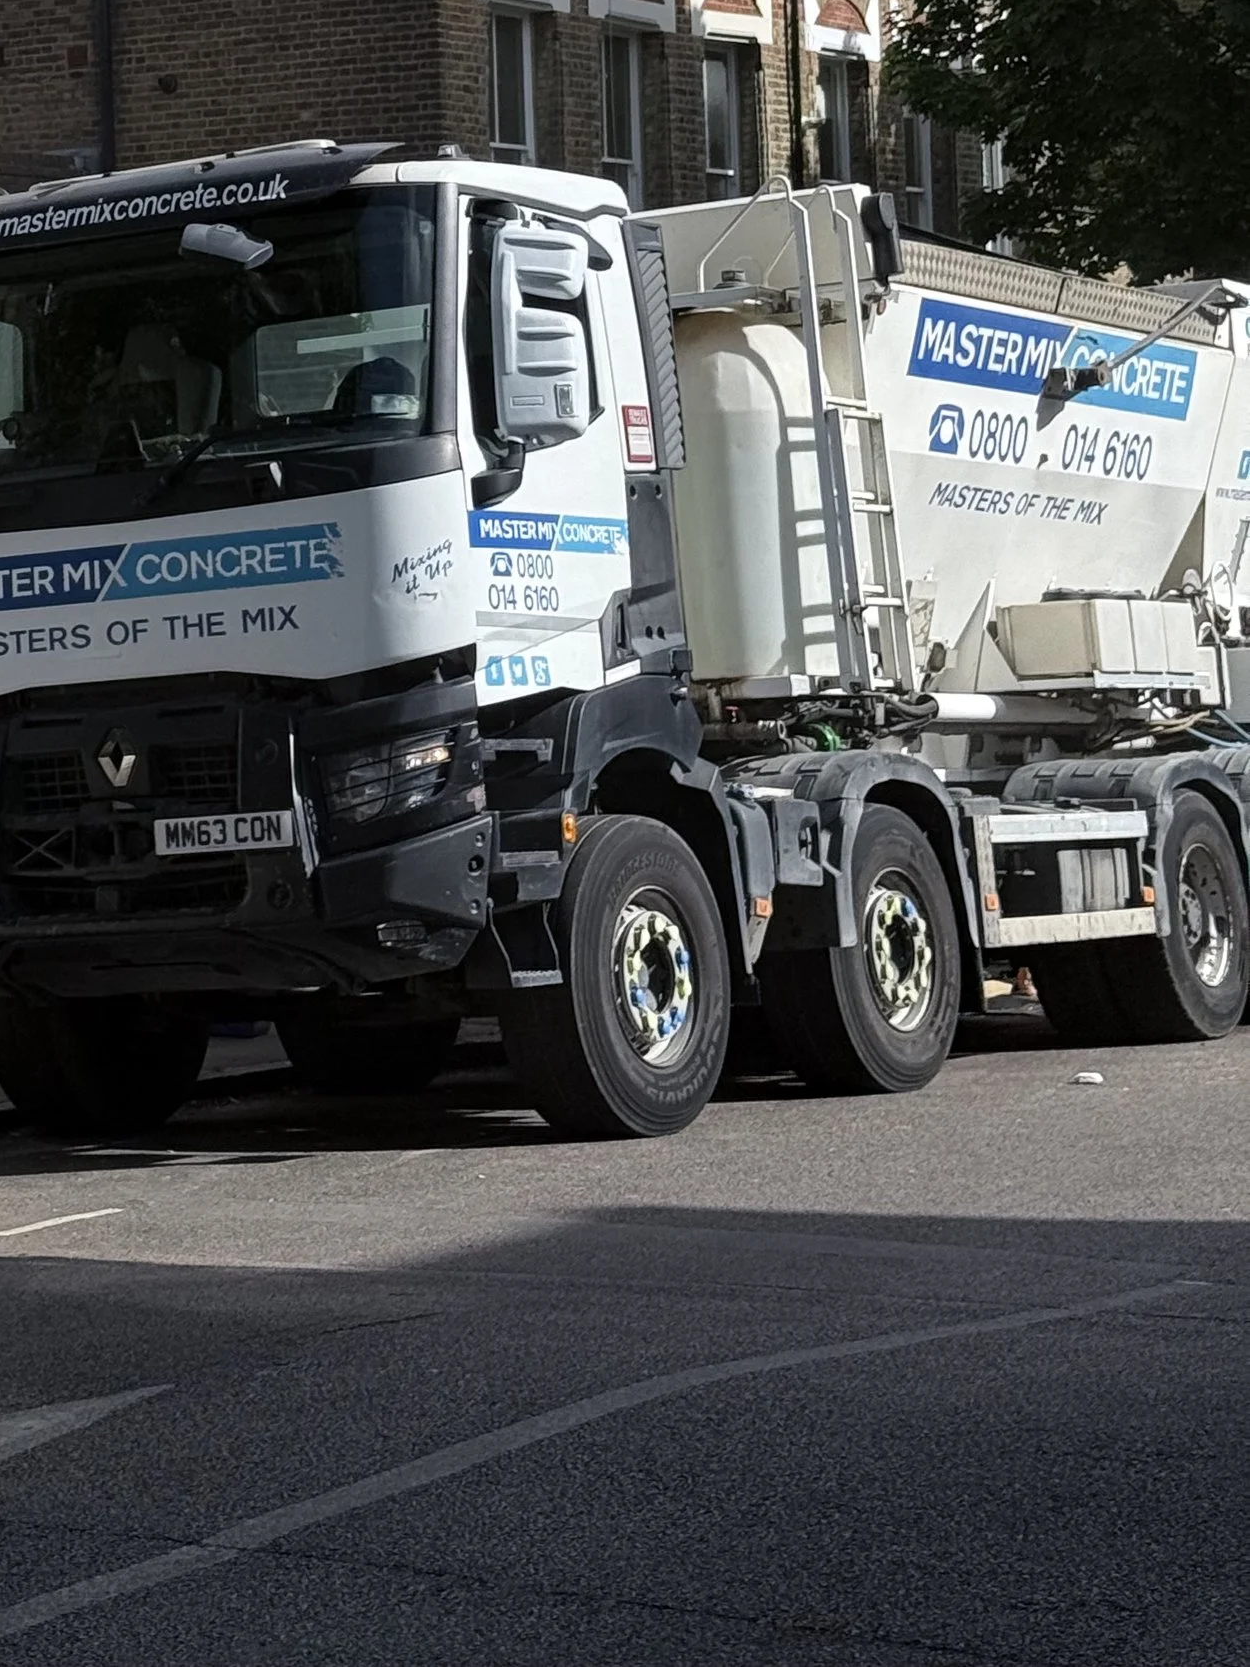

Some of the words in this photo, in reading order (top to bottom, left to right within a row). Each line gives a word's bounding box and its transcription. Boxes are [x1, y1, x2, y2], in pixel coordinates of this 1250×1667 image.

[917, 317, 1023, 375] MASTER
[968, 409, 1028, 465] 0800
[1061, 423, 1101, 474] 014
[1103, 430, 1153, 481] 6160
[929, 482, 1011, 516] MASTERS
[1014, 493, 1041, 516] OF
[1040, 496, 1075, 520] THE
[1073, 499, 1109, 525] MIX
[479, 518, 538, 540] MASTER
[538, 521, 563, 544] MIX
[562, 523, 622, 545] CONCRETE
[63, 553, 129, 595] MIX
[135, 536, 332, 585] CONCRETE
[391, 538, 452, 583] Mixing
[516, 552, 554, 579] 0800
[405, 574, 420, 594] it
[488, 584, 517, 611] 014
[523, 585, 560, 612] 6160
[105, 618, 149, 645] OF
[162, 611, 227, 641] THE
[242, 605, 300, 634] MIX
[165, 819, 227, 849] MM63
[234, 815, 282, 844] CON
